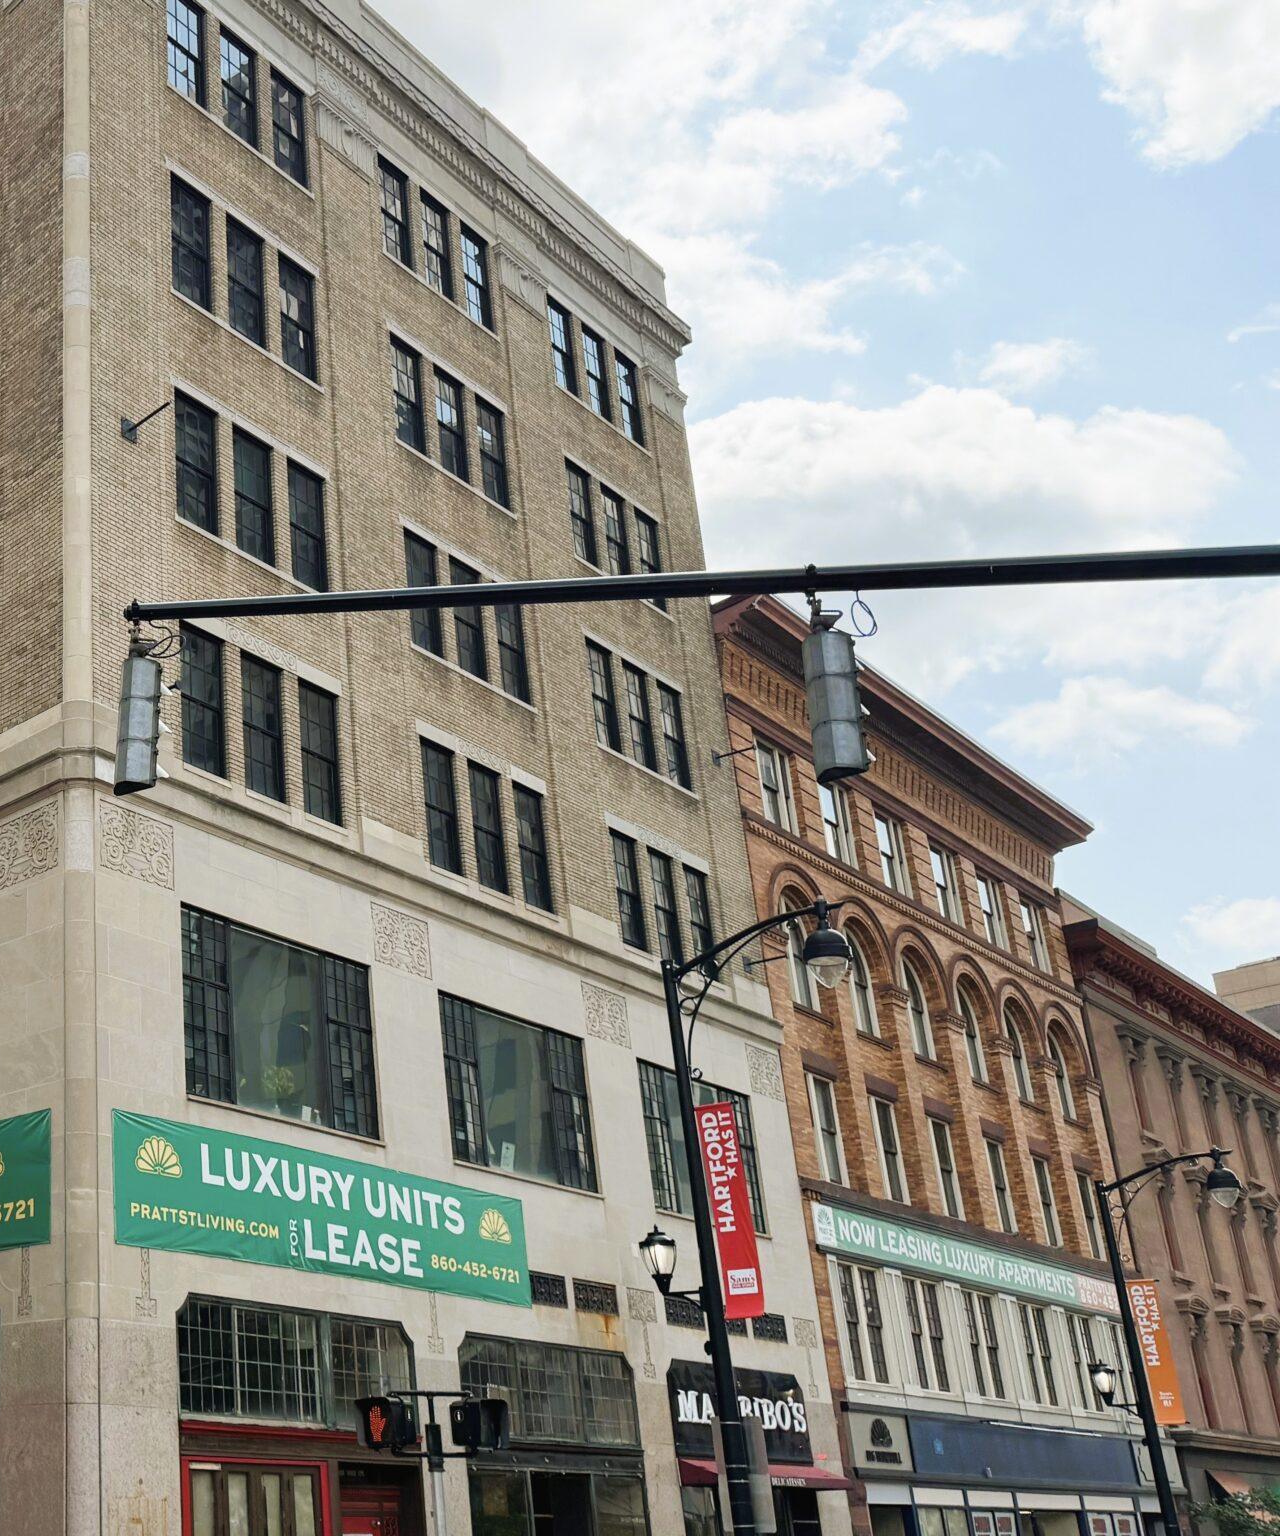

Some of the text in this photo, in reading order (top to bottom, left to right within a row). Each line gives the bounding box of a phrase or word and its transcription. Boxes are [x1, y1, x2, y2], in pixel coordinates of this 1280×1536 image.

[718, 1111, 738, 1163] HAS IT
[201, 1143, 465, 1235] LUXURY UNITS
[701, 1112, 736, 1232] HARTFORD
[130, 1202, 280, 1240] PRATTSTLIVING.COM
[289, 1219, 299, 1257] FOR
[303, 1218, 424, 1278] LEASE
[430, 1254, 521, 1285] 860-452-6721
[838, 1216, 876, 1248] NOW
[879, 1227, 942, 1265] LEASING
[943, 1245, 996, 1278] LUXURY
[998, 1260, 1076, 1297] APARTMENTS
[1131, 1285, 1160, 1366] HARTFORD
[1143, 1285, 1160, 1320] HAS IT
